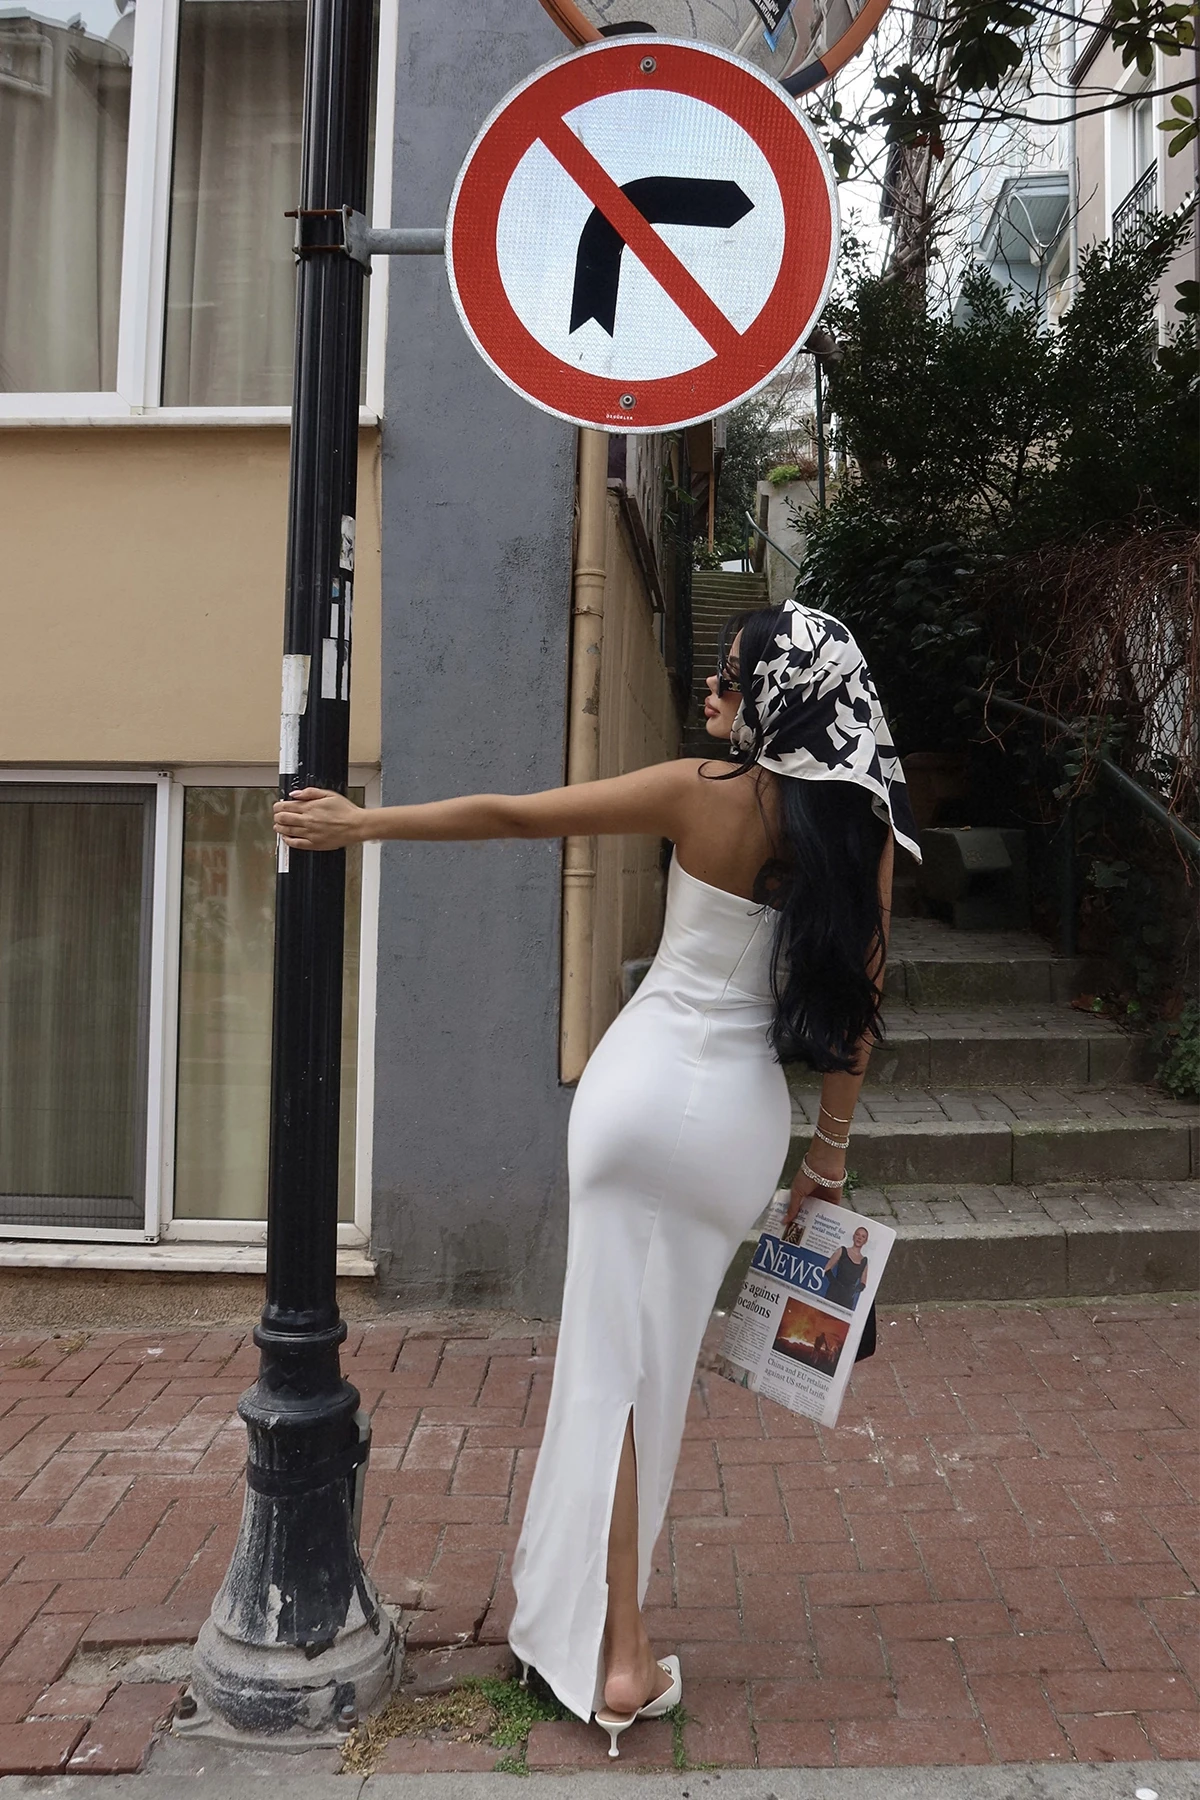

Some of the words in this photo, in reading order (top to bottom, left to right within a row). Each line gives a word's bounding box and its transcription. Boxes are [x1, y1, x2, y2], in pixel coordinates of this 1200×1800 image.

[811, 1225, 826, 1234] social
[758, 1239, 826, 1291] NEWS
[736, 1296, 772, 1319] ocations
[749, 1284, 781, 1305] against
[764, 1367, 786, 1382] against
[785, 1375, 796, 1386] US
[795, 1381, 810, 1393] steel
[809, 1387, 826, 1400] tariffs
[767, 1357, 785, 1371] China
[785, 1367, 797, 1377] and
[796, 1370, 807, 1381] EU
[806, 1376, 830, 1392] retaliate
